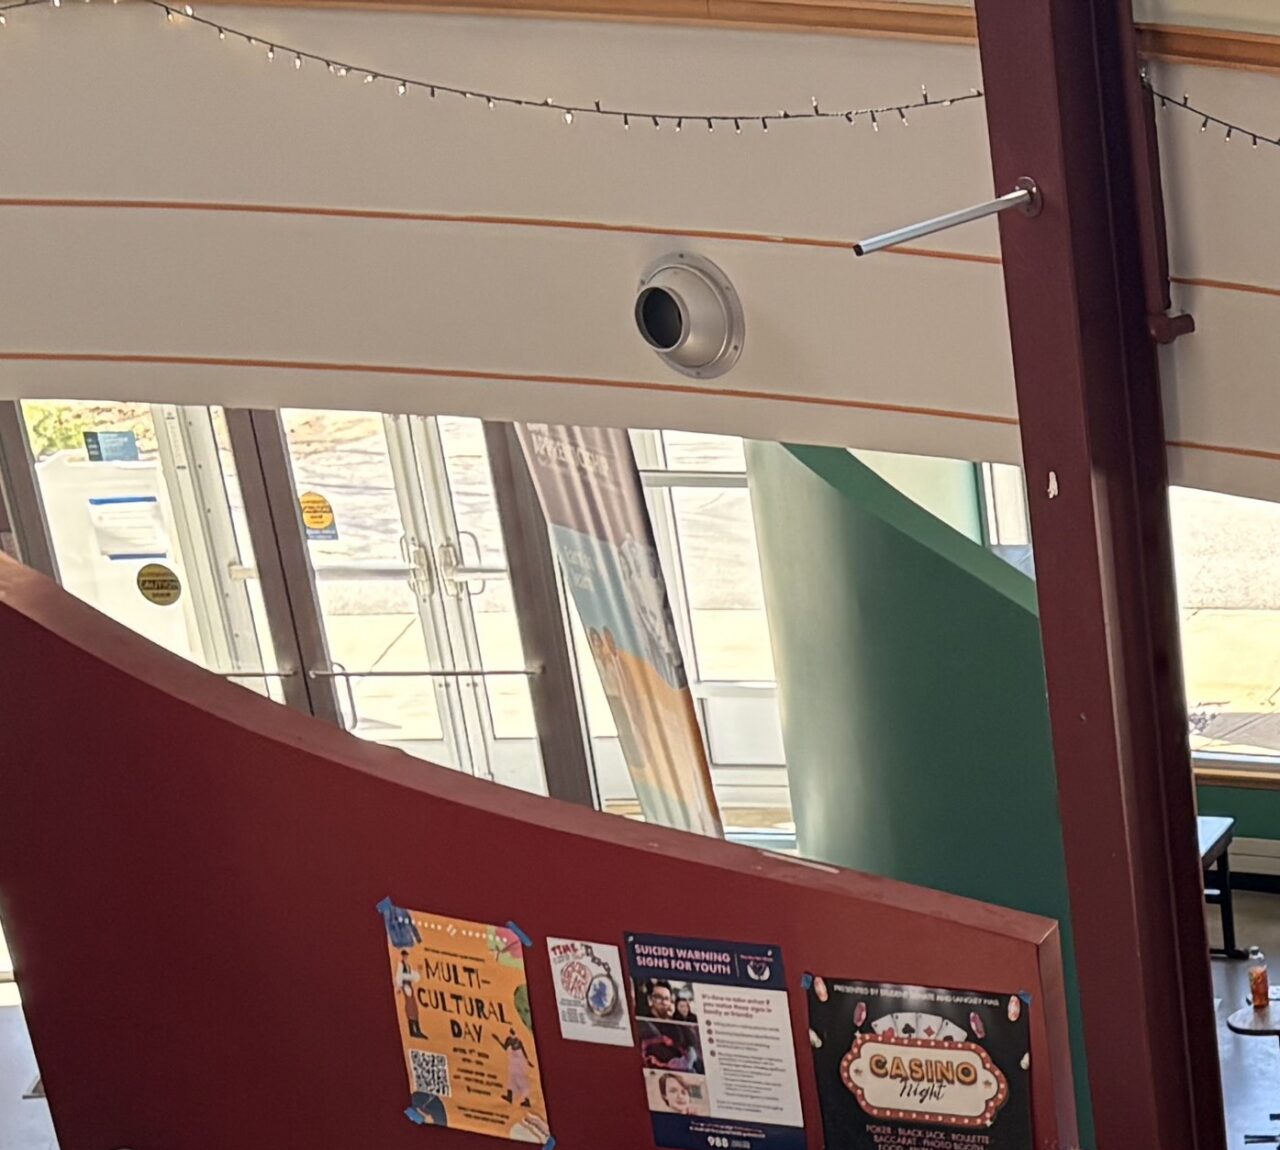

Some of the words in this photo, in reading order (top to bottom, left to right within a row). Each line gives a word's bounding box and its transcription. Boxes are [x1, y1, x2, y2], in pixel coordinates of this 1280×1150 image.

[634, 943, 675, 959] SUICIDE
[676, 948, 731, 963] WARNING
[424, 958, 491, 989] MULTI-
[636, 956, 670, 969] SIGNS
[671, 958, 693, 972] FOR
[693, 960, 731, 975] YOUTH
[417, 987, 512, 1025] CULTURAL
[450, 1019, 482, 1043] DAY
[869, 1053, 978, 1086] CASINO
[899, 1077, 947, 1104] Night
[707, 1135, 729, 1149] 988
[865, 1123, 891, 1134] POKER
[898, 1127, 923, 1138] BLACK
[925, 1130, 946, 1140] JACK
[952, 1132, 990, 1144] ROULETTE
[873, 1134, 917, 1146] BACCARAT
[923, 1139, 952, 1150] PHOTO
